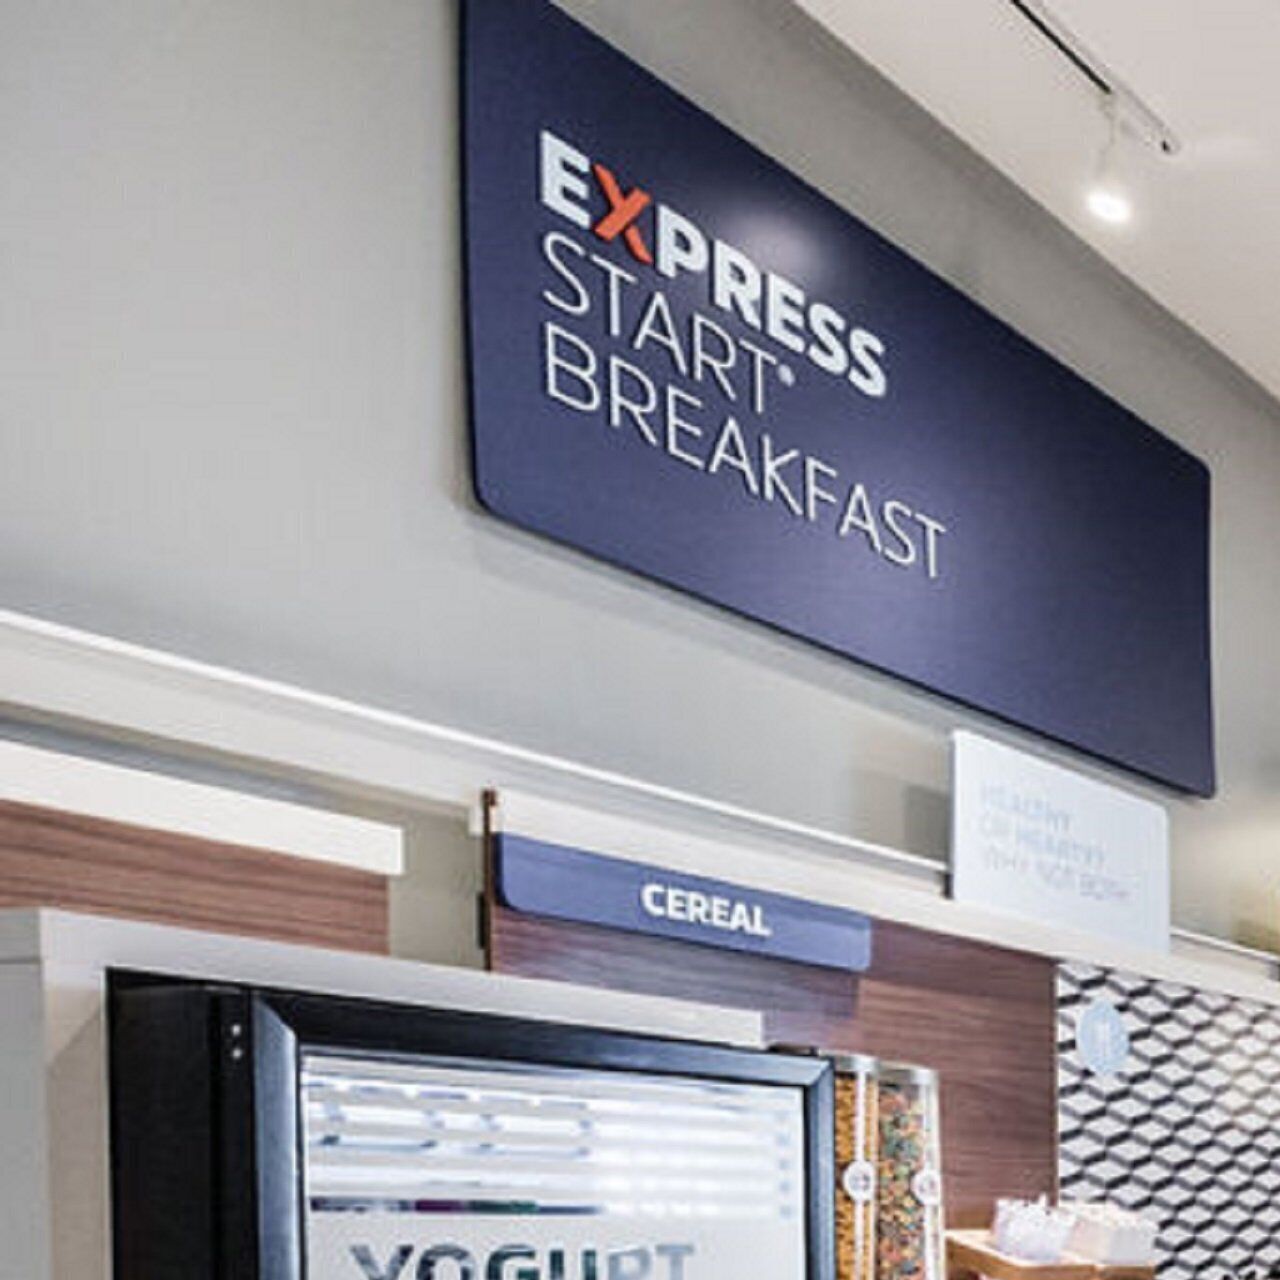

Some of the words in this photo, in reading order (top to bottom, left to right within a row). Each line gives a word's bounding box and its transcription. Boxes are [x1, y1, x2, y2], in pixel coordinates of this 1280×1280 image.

[540, 130, 888, 398] EXPRESS
[545, 321, 946, 579] BREAKFAST
[641, 882, 774, 937] CEREAL
